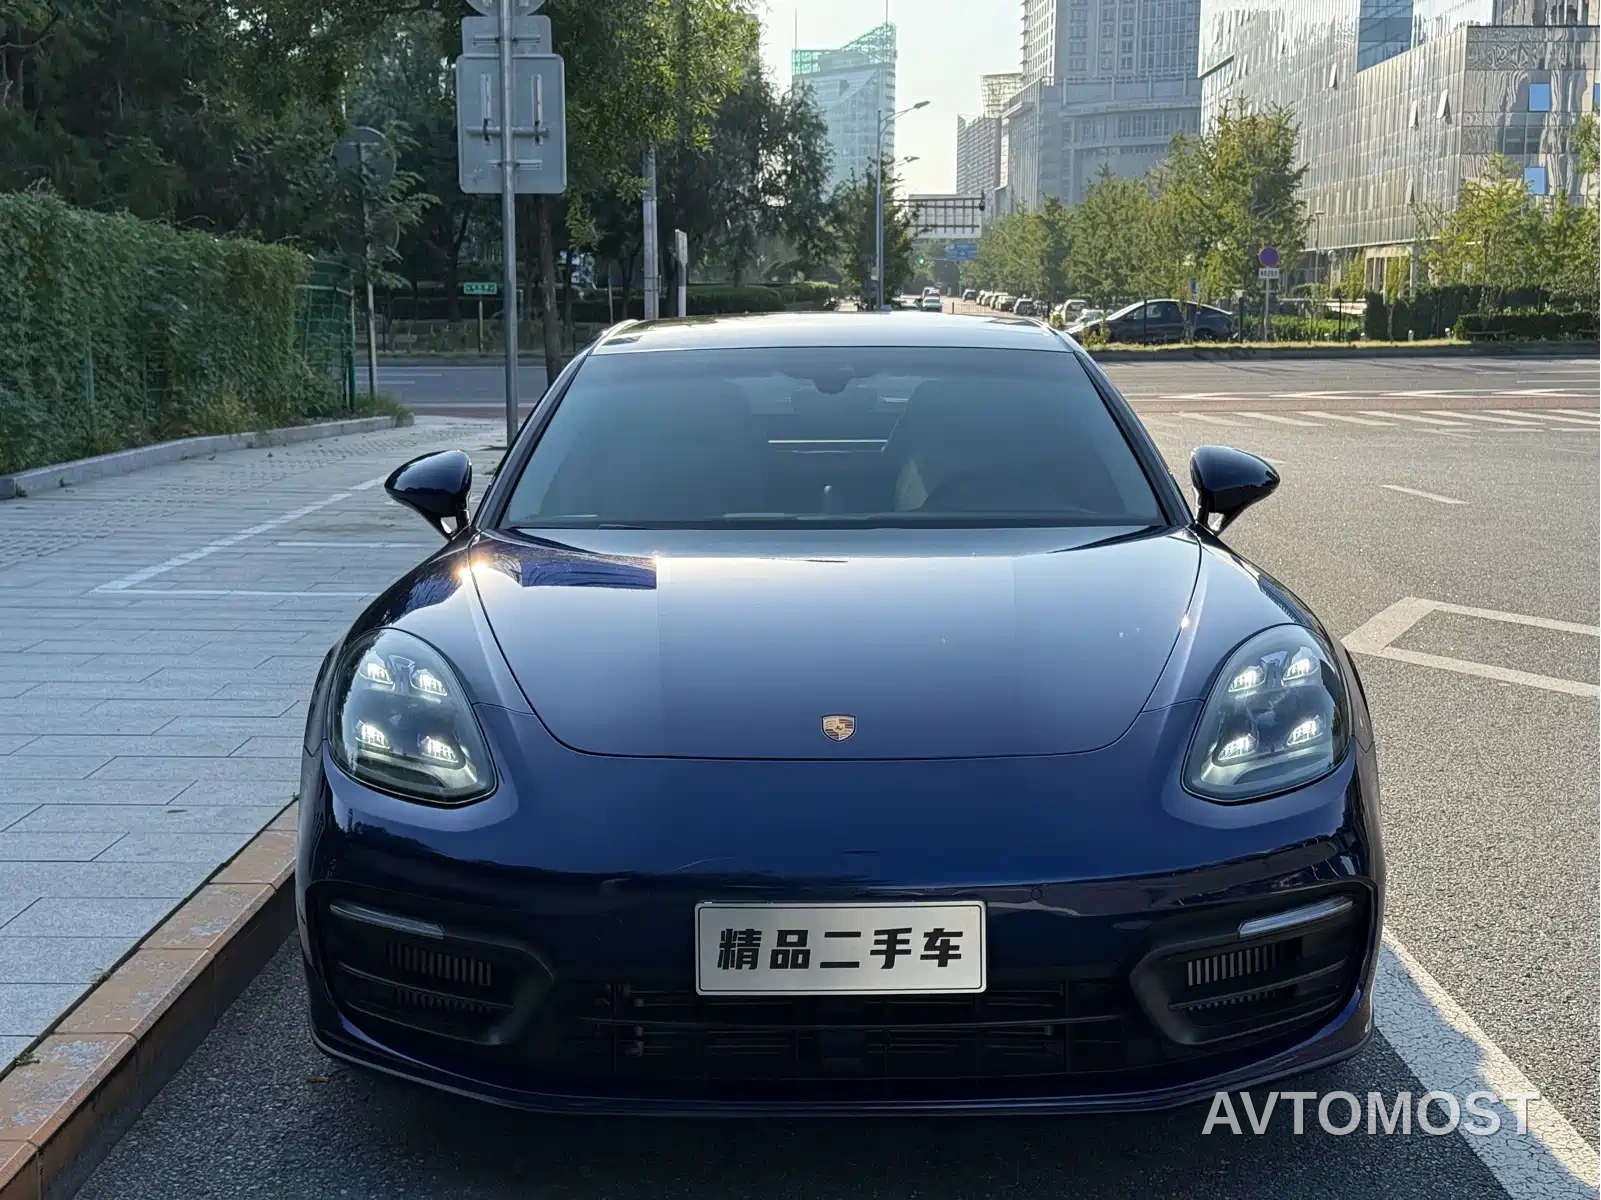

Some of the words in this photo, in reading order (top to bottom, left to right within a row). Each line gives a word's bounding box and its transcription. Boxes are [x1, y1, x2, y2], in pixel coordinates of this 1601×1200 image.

[717, 927, 963, 970] 精品二手车
